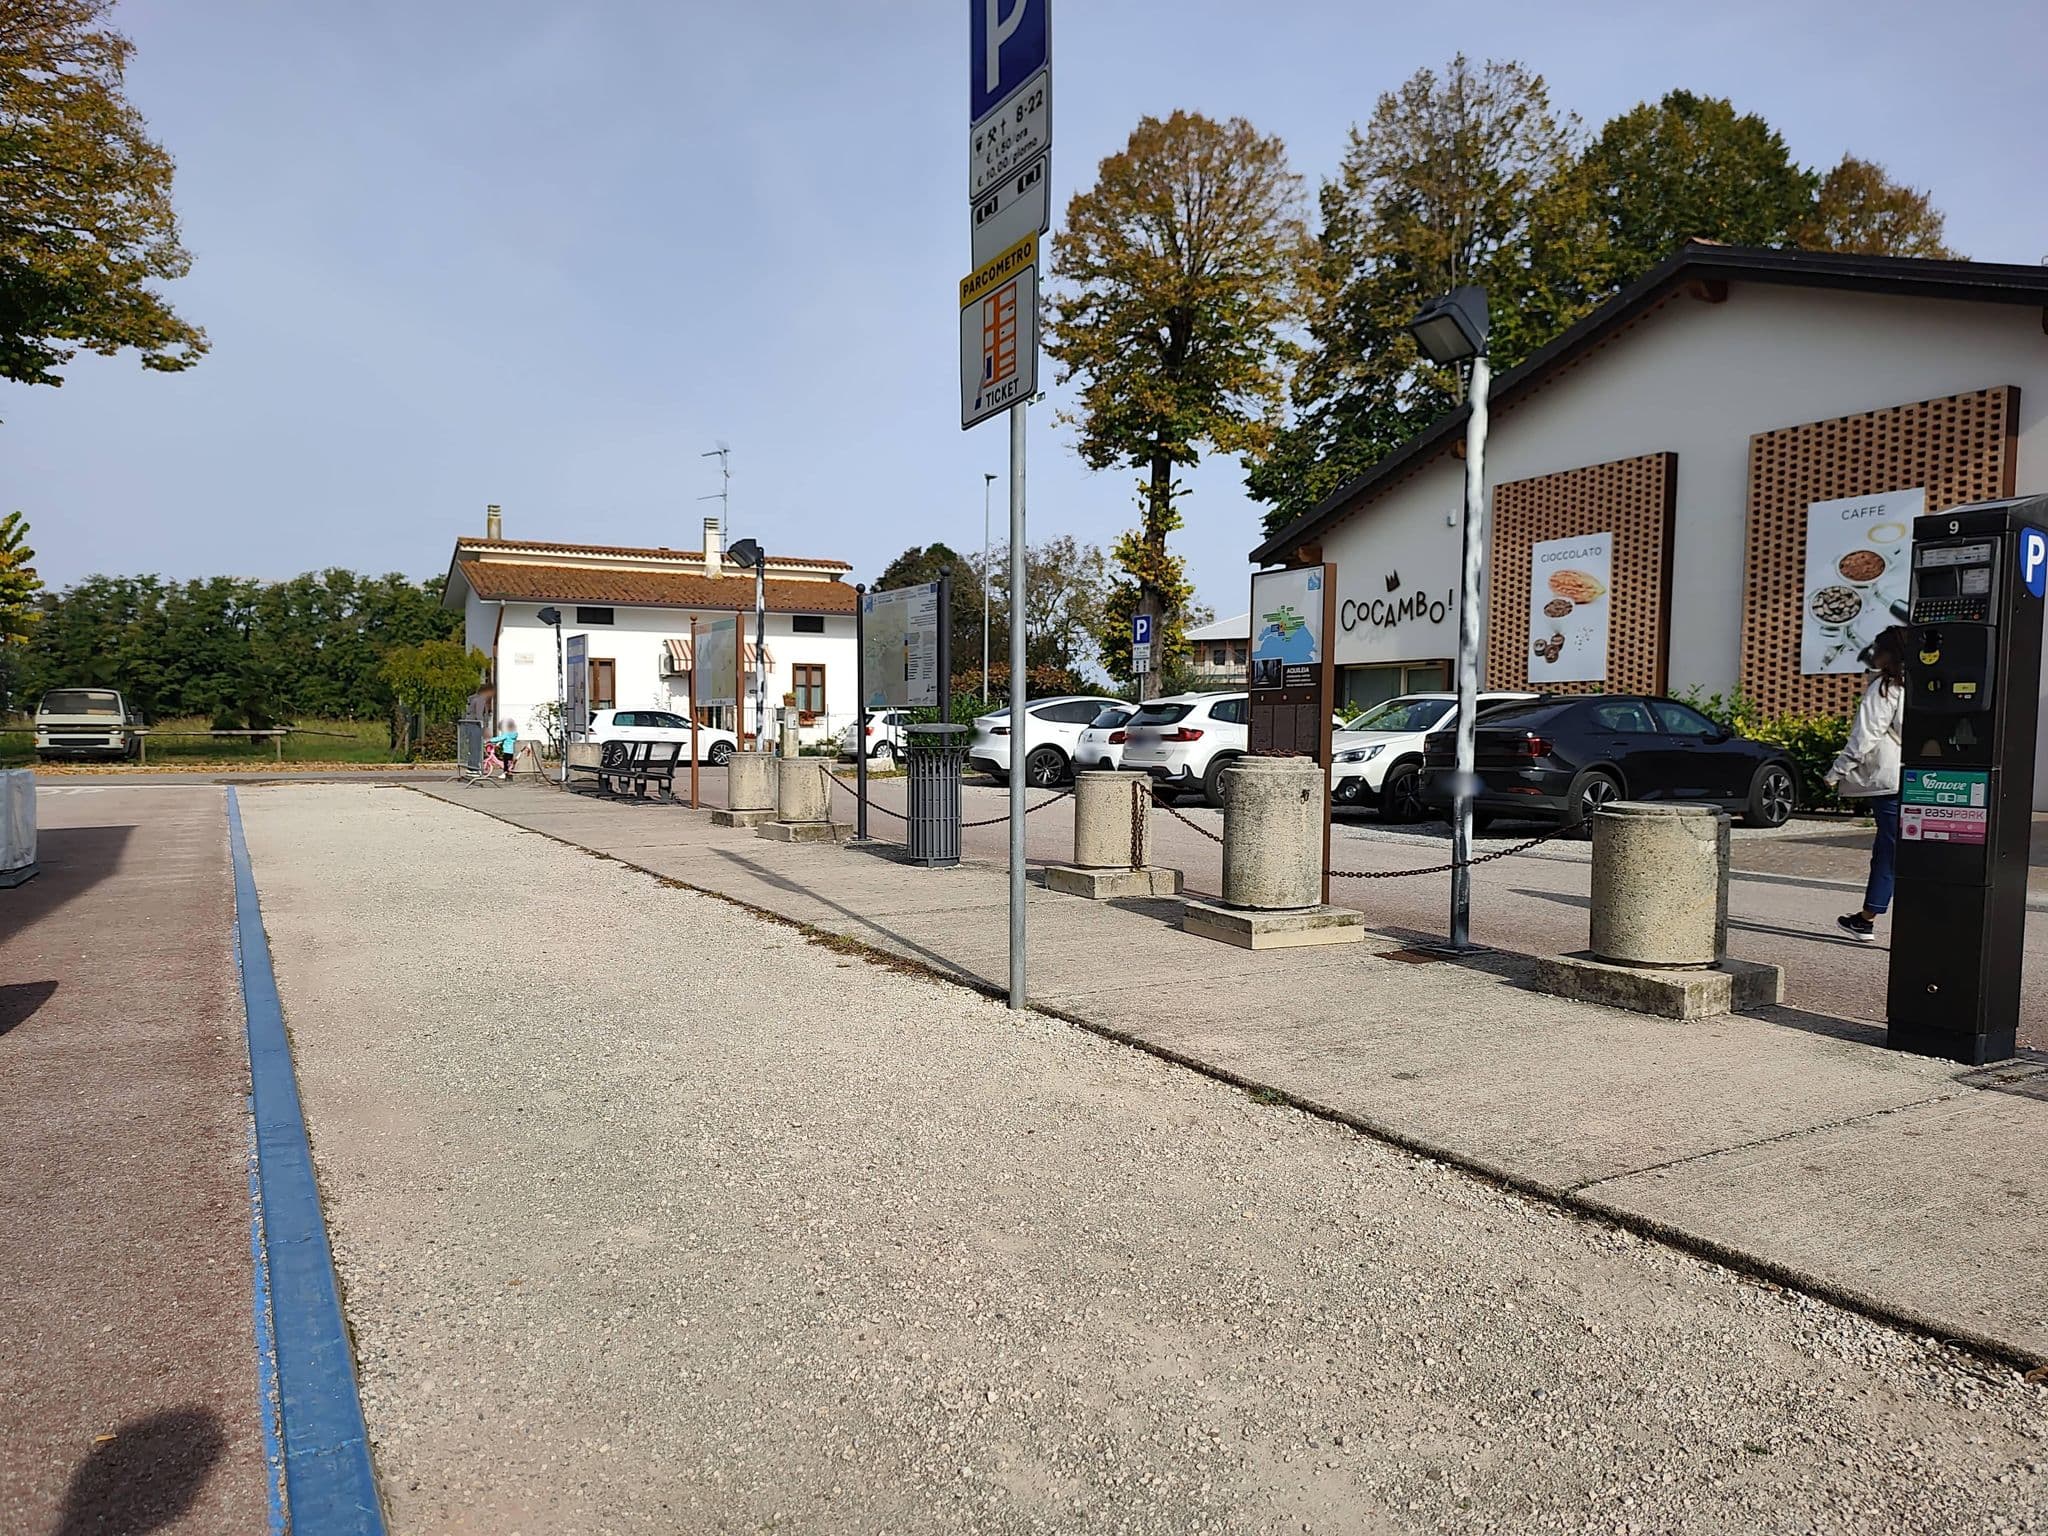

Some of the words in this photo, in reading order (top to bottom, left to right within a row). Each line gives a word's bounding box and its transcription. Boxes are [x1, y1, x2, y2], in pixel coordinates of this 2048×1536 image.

[985, 0, 1027, 94] P
[963, 242, 1032, 298] PARCOMETRO
[986, 377, 1019, 408] TICKET
[1949, 520, 1960, 534] 9
[1540, 546, 1602, 563] CIOCCOLATO
[2026, 534, 2046, 583] P
[1136, 619, 1148, 641] P
